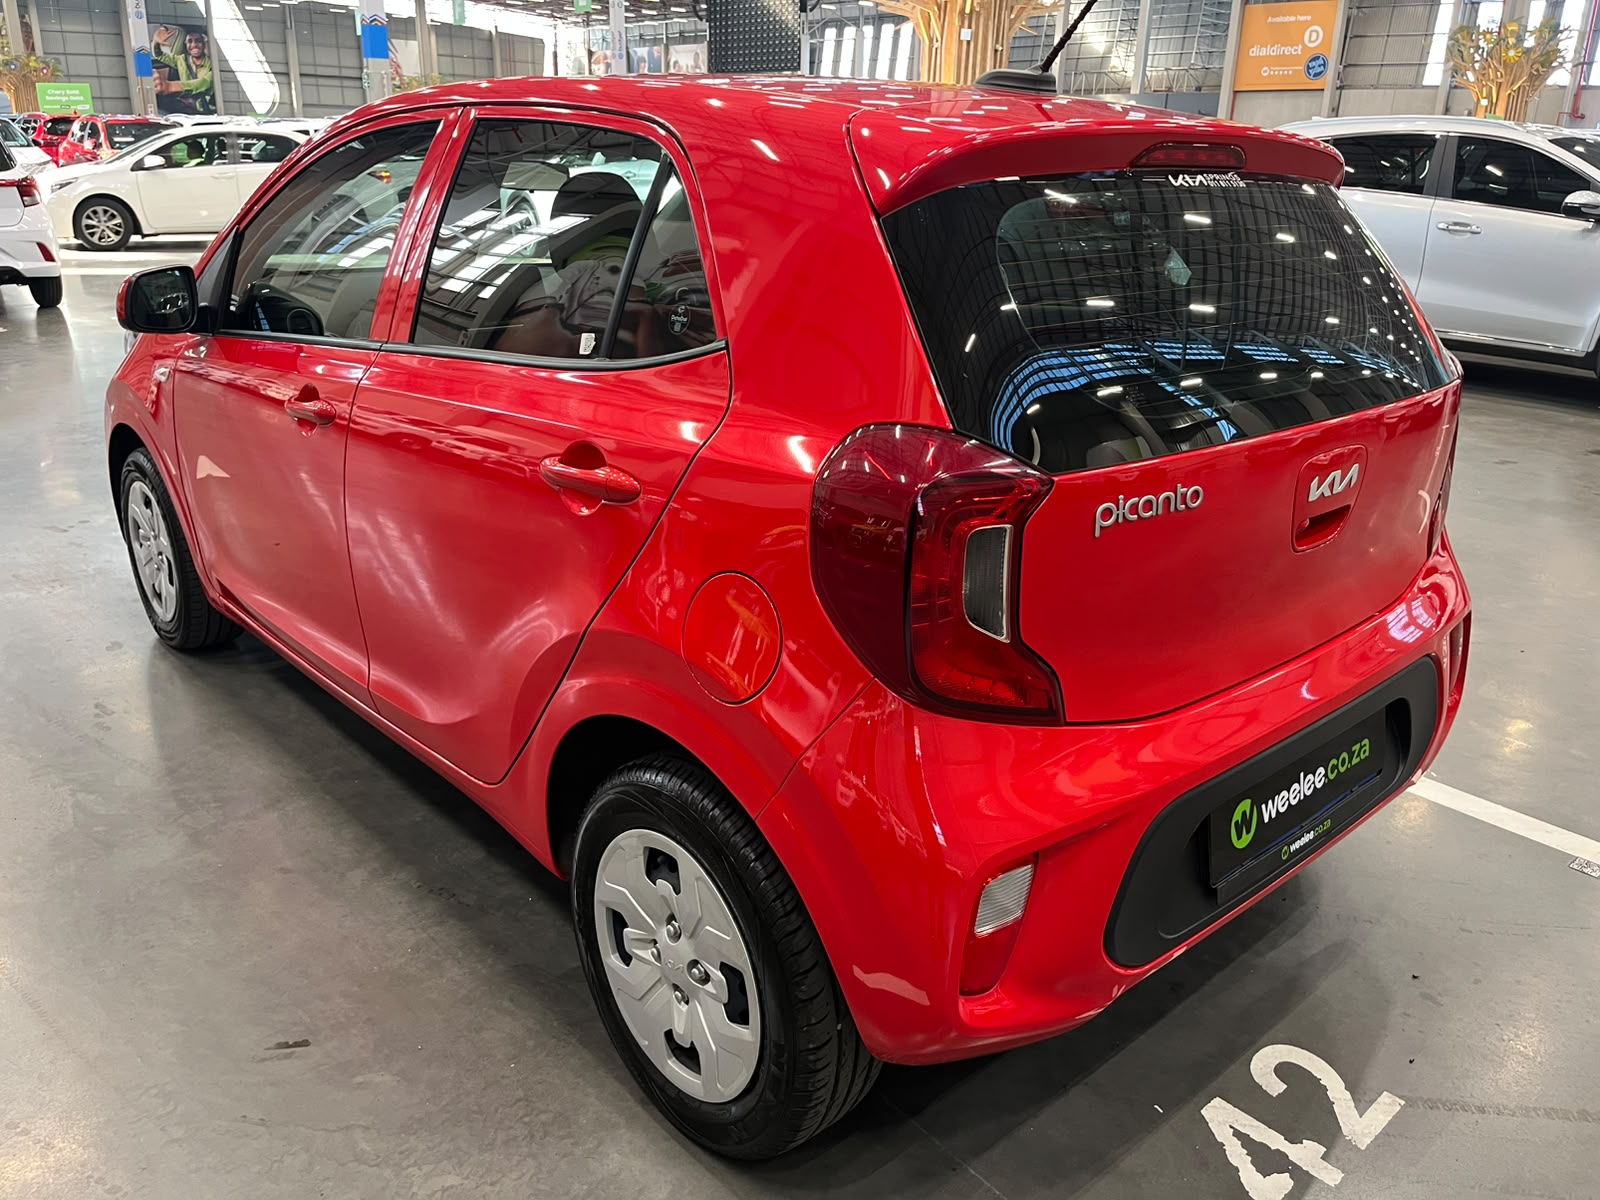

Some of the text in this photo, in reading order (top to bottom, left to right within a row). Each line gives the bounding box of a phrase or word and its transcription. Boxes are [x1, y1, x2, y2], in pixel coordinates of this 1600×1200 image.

[1249, 44, 1302, 57] dialdirect
[1168, 171, 1241, 187] KIA SPRINGS
[1308, 463, 1360, 502] KIA
[1094, 483, 1204, 538] picanto
[1261, 738, 1370, 824] weelee.co.za
[1290, 819, 1331, 852] weelee.co.za
[1200, 1044, 1405, 1200] 42
